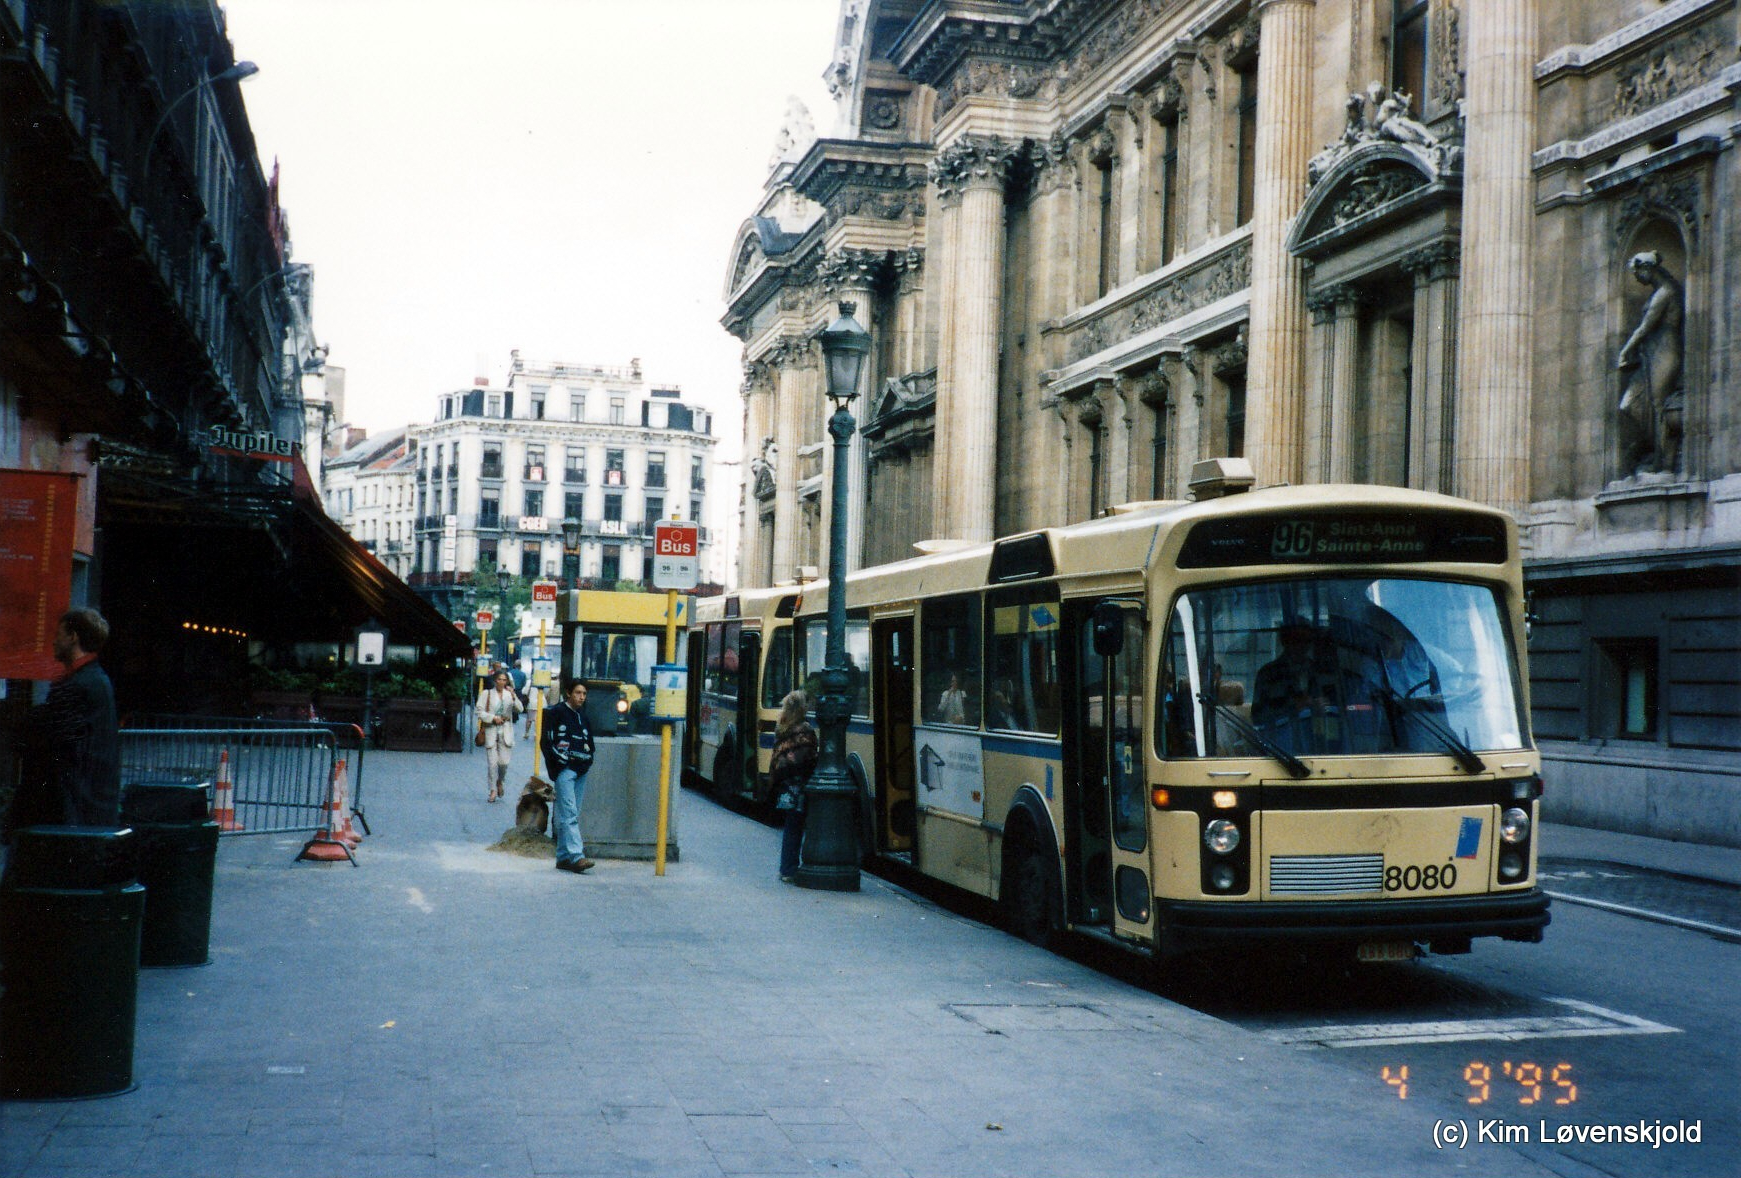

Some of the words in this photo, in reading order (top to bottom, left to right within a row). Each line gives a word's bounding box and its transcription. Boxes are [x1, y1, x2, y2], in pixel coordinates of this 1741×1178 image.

[209, 424, 303, 456] Jupiler
[661, 539, 691, 554] Bus
[1274, 521, 1312, 554] 96
[1316, 538, 1424, 553] Sainte-Anne
[536, 591, 553, 600] Bus
[1384, 863, 1457, 891] 8080
